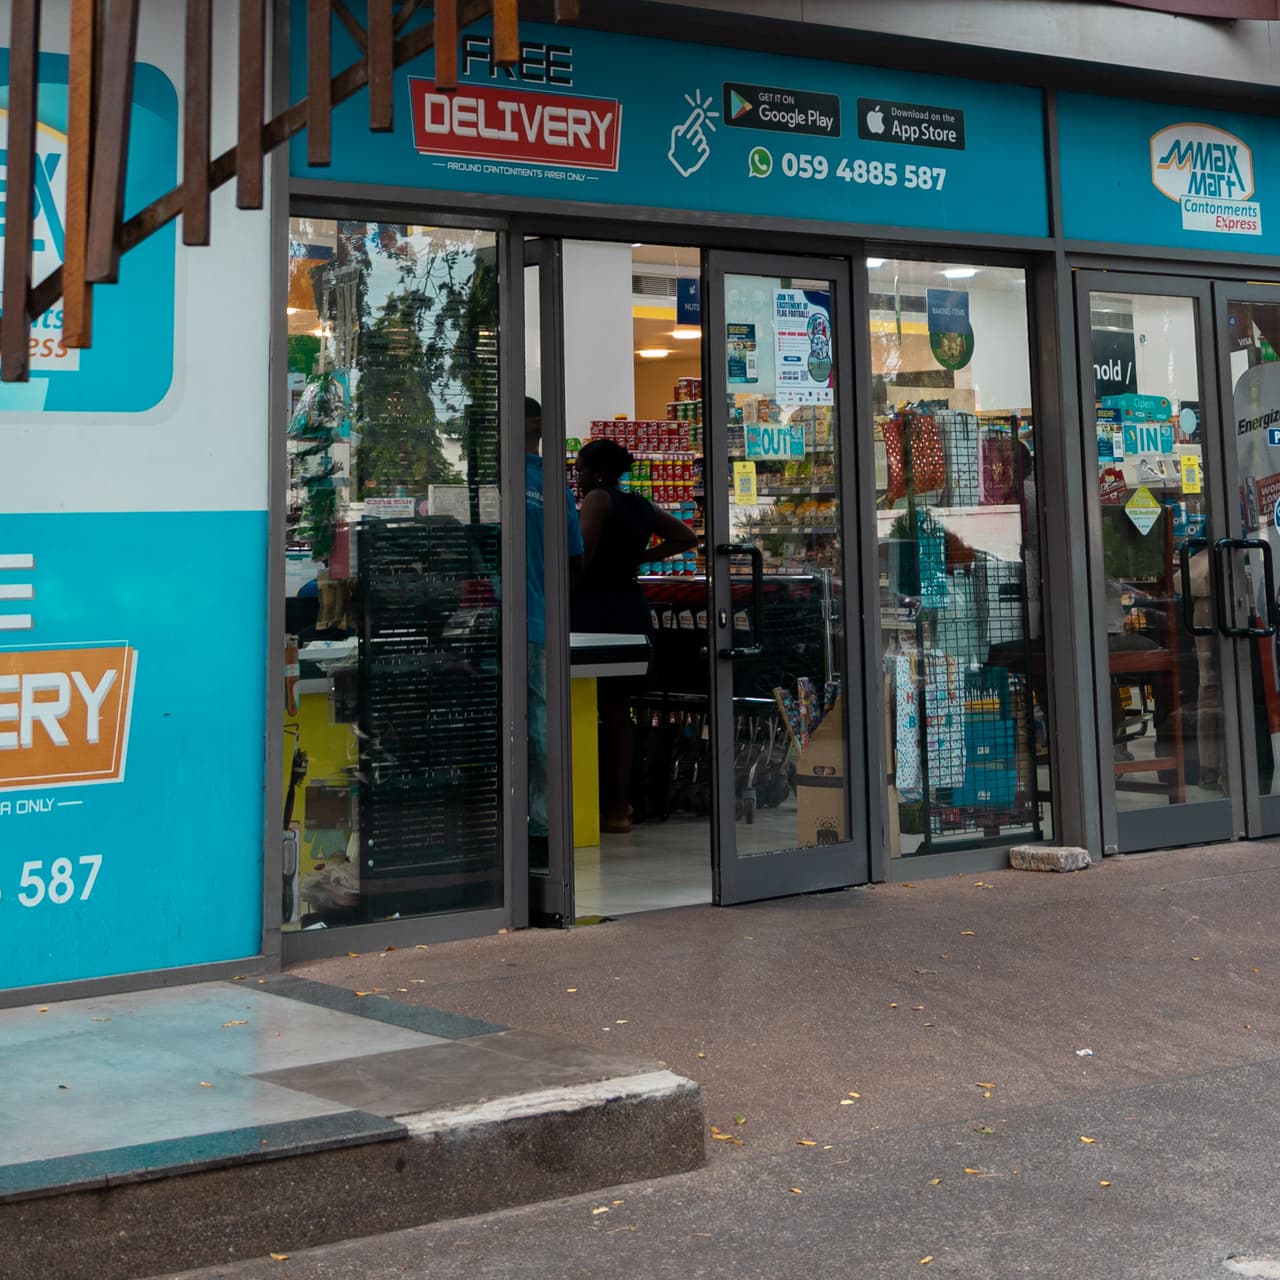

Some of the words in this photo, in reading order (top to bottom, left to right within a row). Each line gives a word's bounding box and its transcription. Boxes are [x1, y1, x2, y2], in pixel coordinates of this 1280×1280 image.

[758, 92, 773, 103] GET
[775, 94, 781, 103] IT
[782, 95, 795, 105] ON
[424, 92, 613, 151] DELIVERY
[758, 104, 806, 127] Google
[808, 110, 834, 131] Play
[891, 107, 929, 120] Download
[931, 113, 941, 122] on
[942, 113, 955, 123] the
[891, 120, 919, 142] App
[921, 123, 957, 143] Store
[447, 161, 481, 172] AROUND
[483, 164, 543, 178] CANTONMENTS
[544, 170, 566, 180] AREA
[567, 172, 586, 182] ONLY
[781, 152, 828, 180] 059
[836, 158, 897, 187] 4885
[904, 164, 947, 191] 587
[1184, 199, 1257, 218] Cantonments
[761, 428, 790, 456] OUT
[1140, 427, 1159, 452] IN
[15, 797, 55, 816] ONLY
[18, 853, 103, 909] 587
